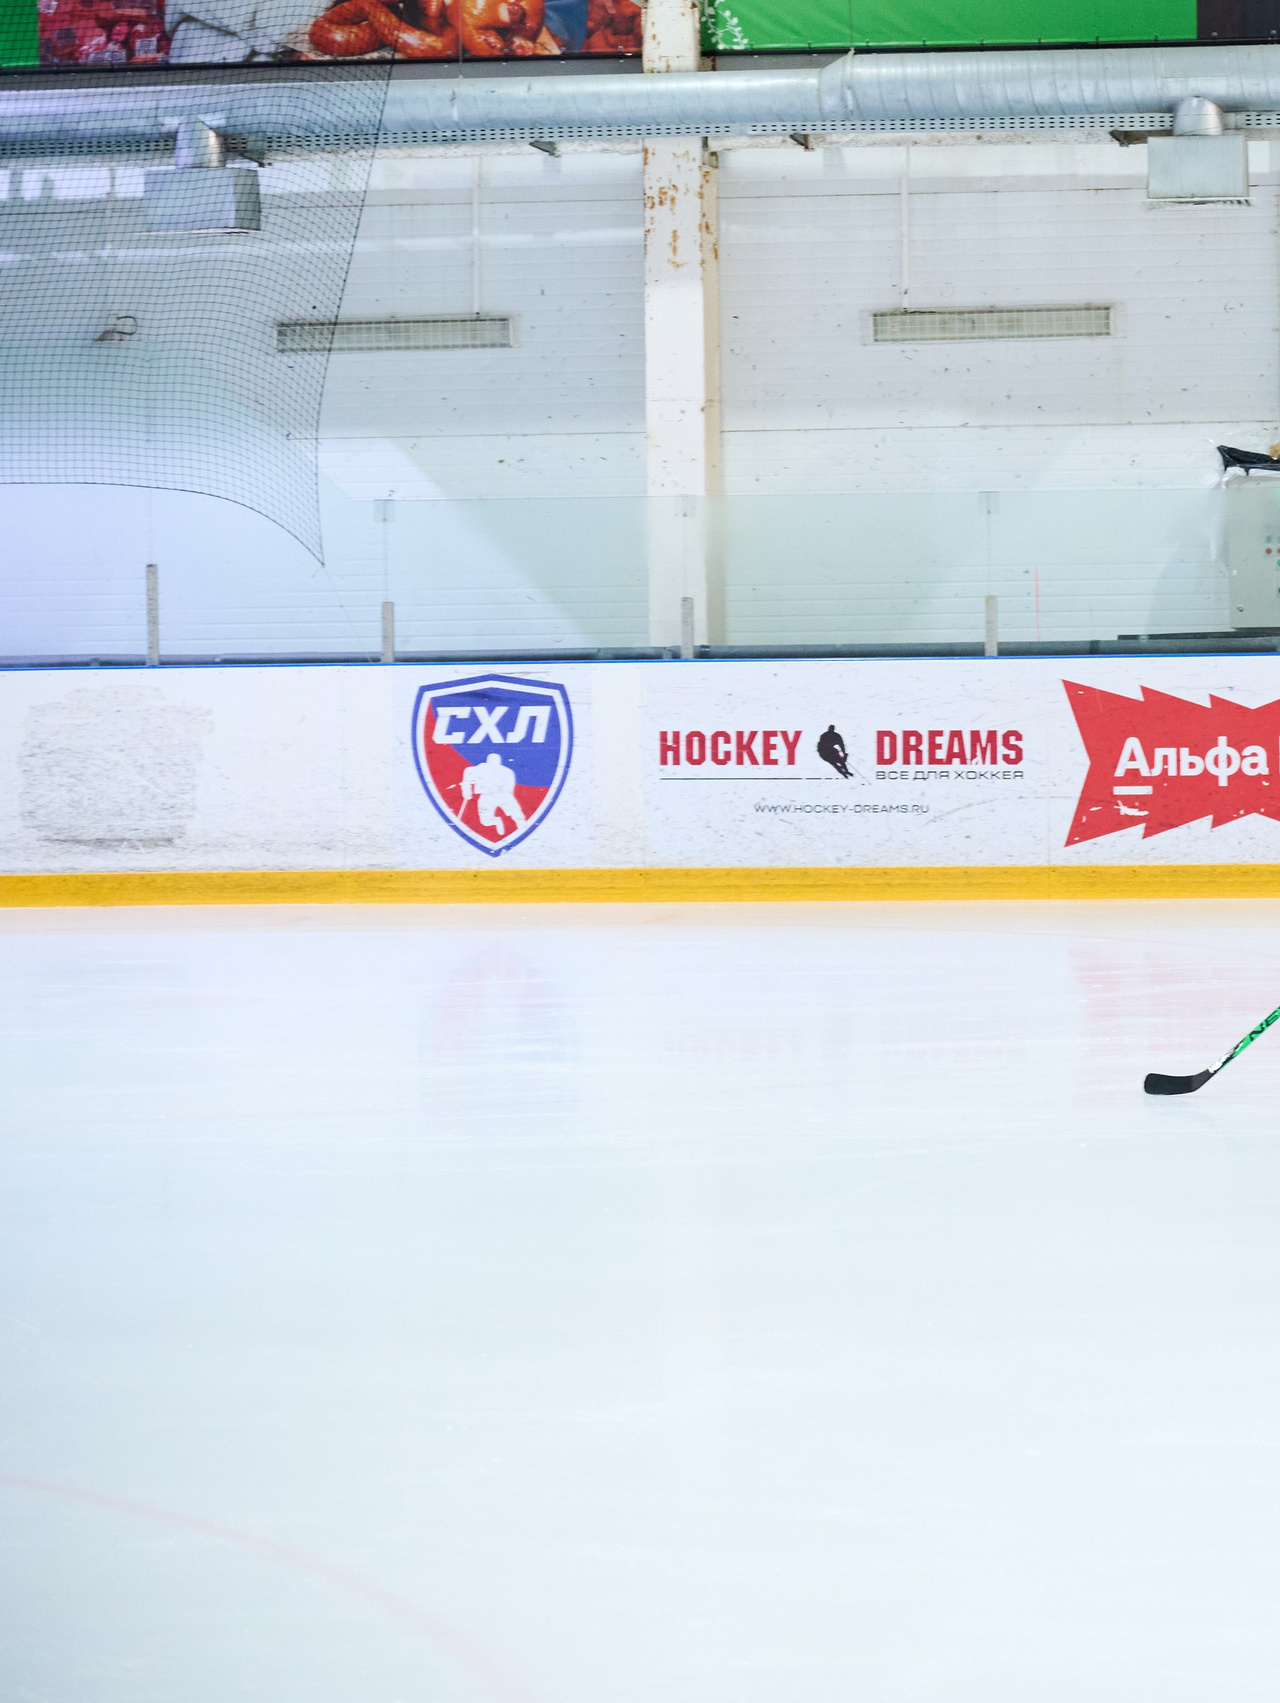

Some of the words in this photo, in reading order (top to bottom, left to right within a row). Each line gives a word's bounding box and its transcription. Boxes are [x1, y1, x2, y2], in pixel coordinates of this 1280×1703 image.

[432, 705, 551, 744] СХЛ
[659, 730, 802, 766] HOCKEY
[876, 729, 1024, 766] DREAMS
[1114, 735, 1269, 787] Альфа
[876, 770, 909, 780] ВСЕ
[912, 770, 950, 781] ДЛЯ
[953, 770, 1024, 780] ХОККЕЯ
[753, 804, 930, 814] WWW.HOCKEY-DREAMS.RU
